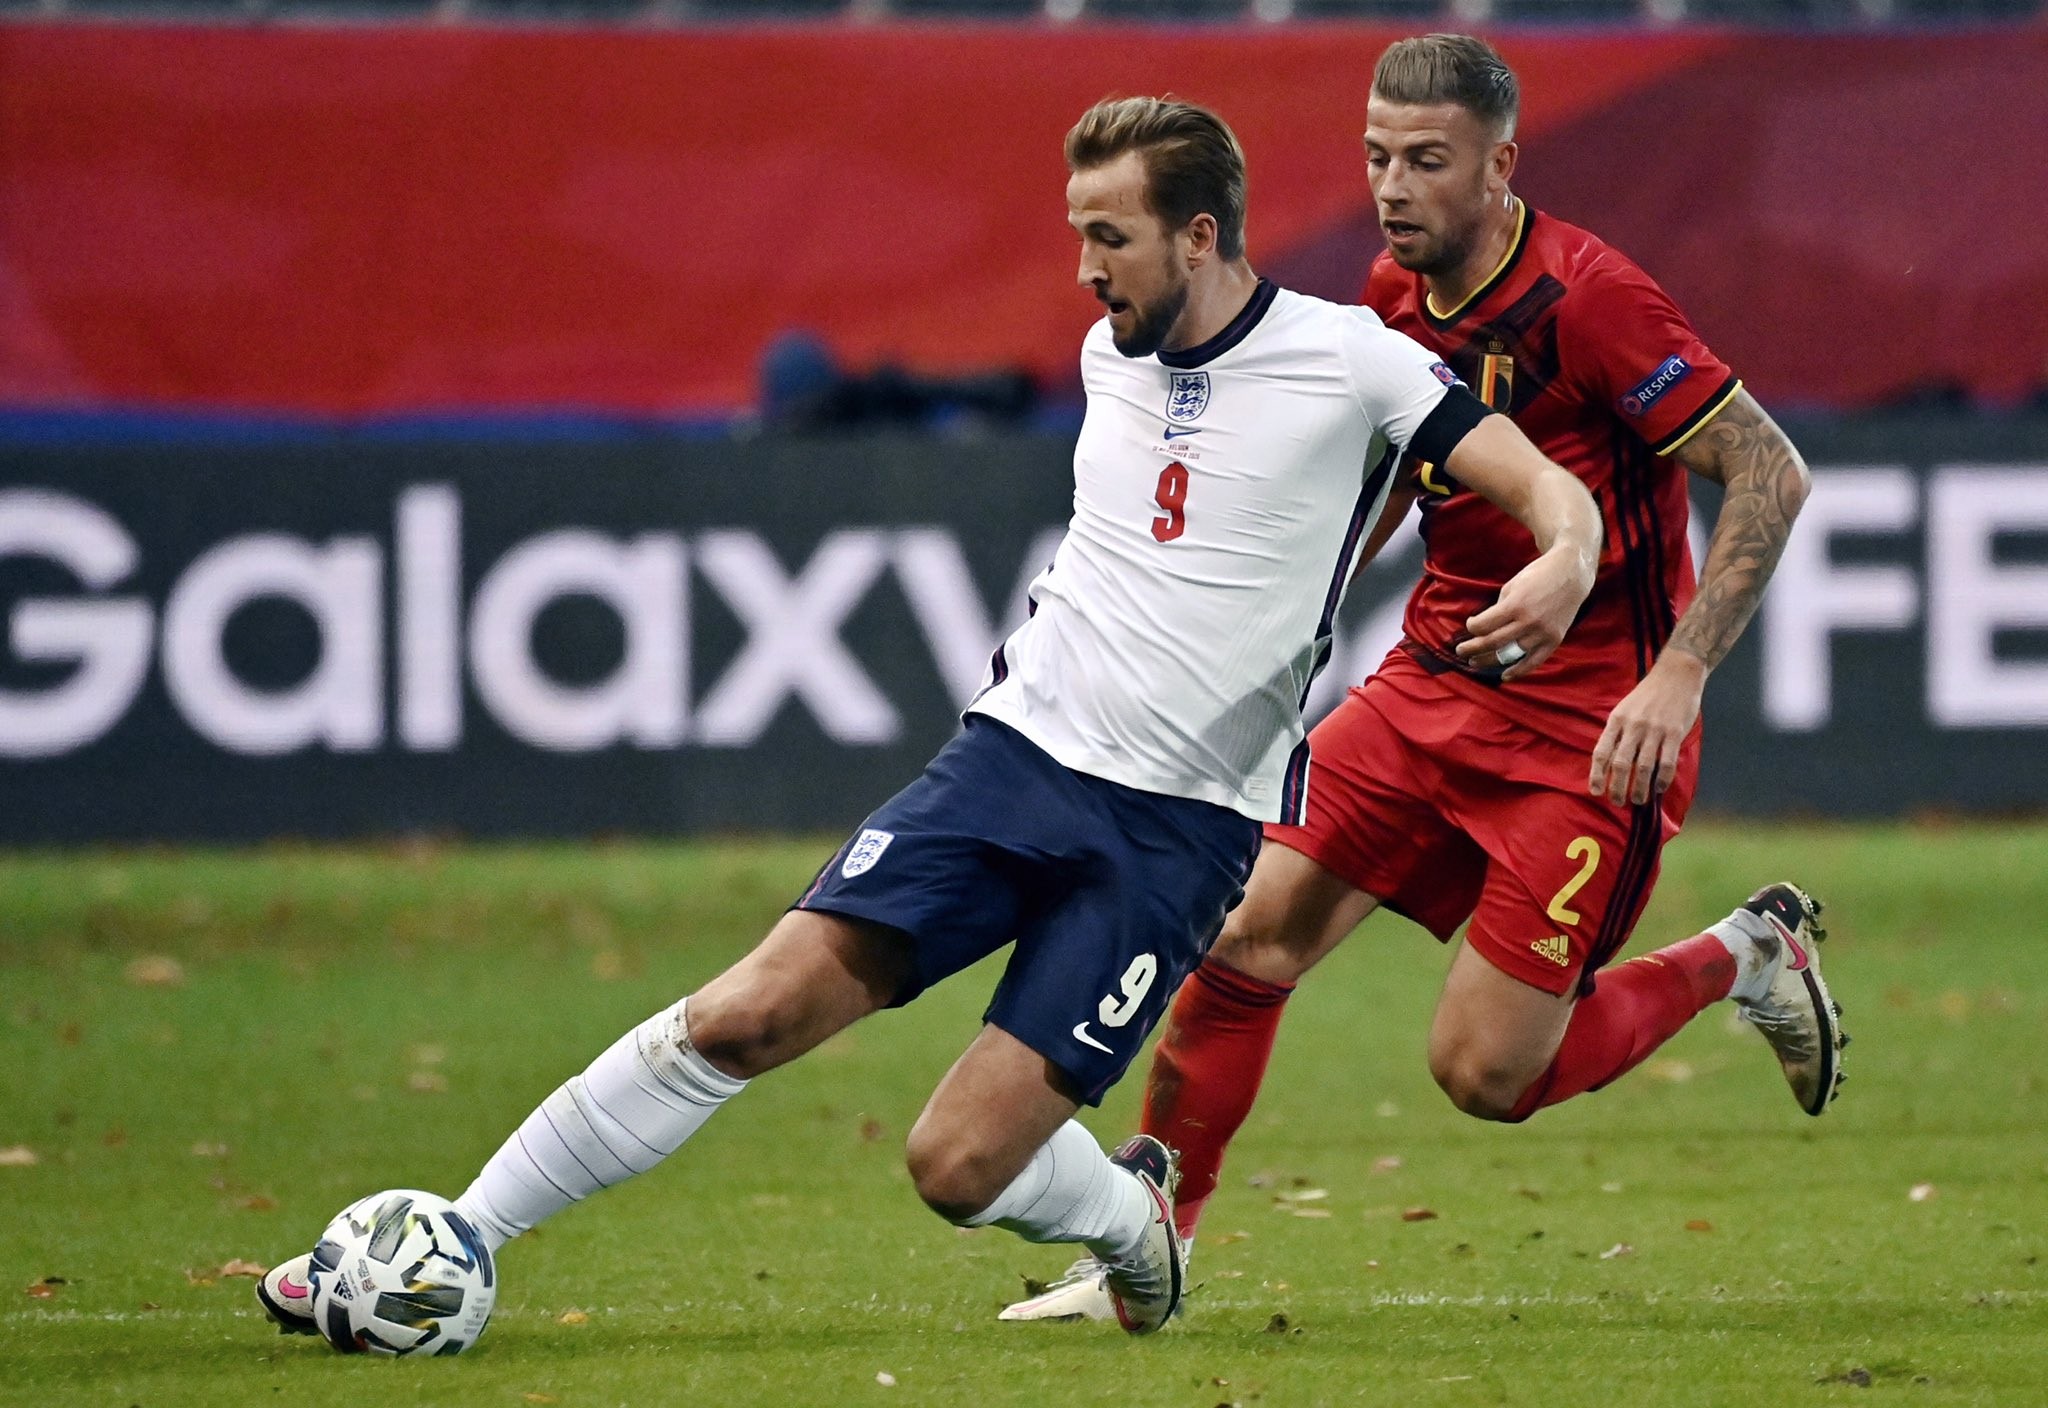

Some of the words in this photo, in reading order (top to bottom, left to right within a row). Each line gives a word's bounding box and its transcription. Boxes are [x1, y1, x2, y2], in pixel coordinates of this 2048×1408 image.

[1638, 357, 1686, 403] RESPECT
[1151, 461, 1189, 542] 9
[1762, 466, 2048, 731] FE
[1547, 836, 1601, 926] 2
[1098, 952, 1157, 1028] 9
[1530, 940, 1570, 967] adidas
